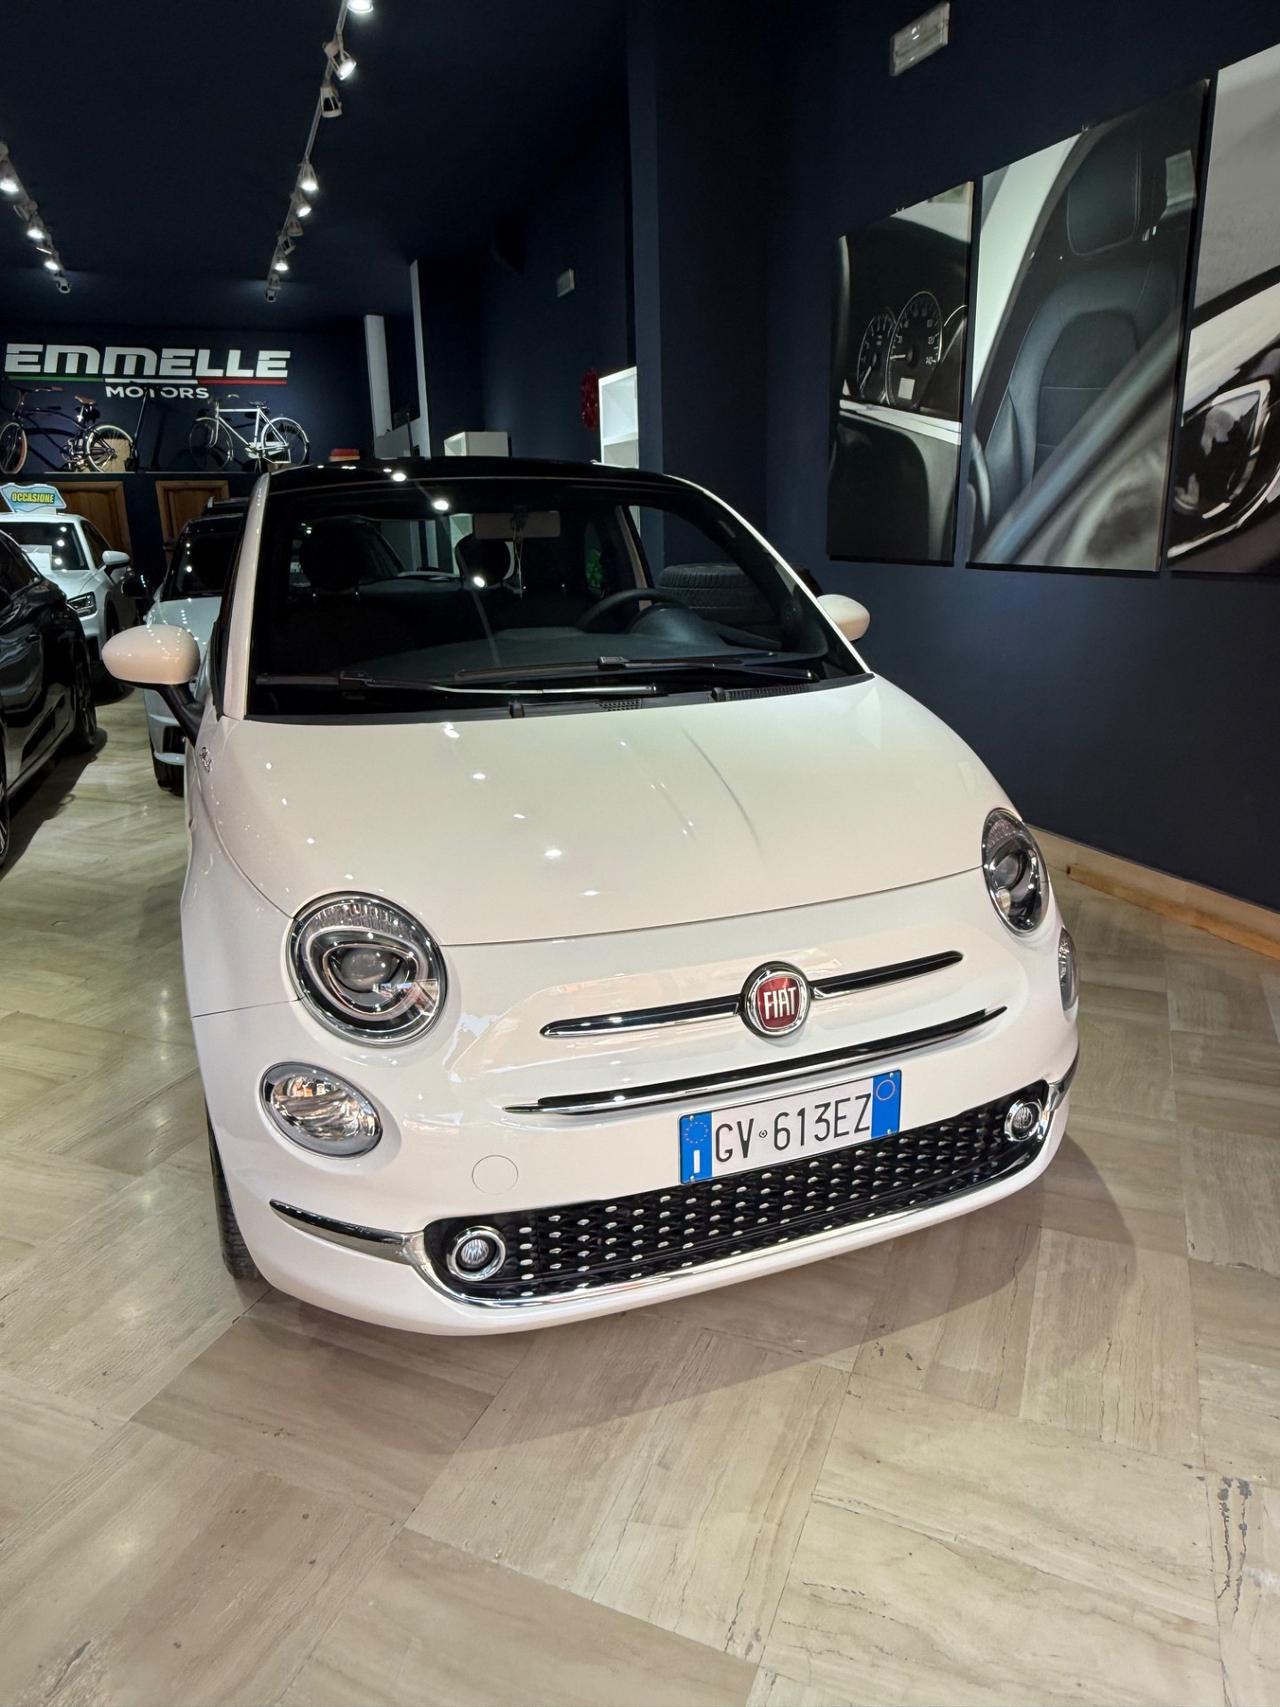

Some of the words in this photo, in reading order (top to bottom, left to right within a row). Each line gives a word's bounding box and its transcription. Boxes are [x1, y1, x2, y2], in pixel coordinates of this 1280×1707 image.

[5, 343, 291, 378] EMMELLE
[11, 492, 55, 504] OCCASIONE
[763, 986, 797, 1020] FIAT
[715, 1118, 754, 1163] GV
[773, 1093, 872, 1151] 613EZ
[693, 1149, 701, 1174] I
